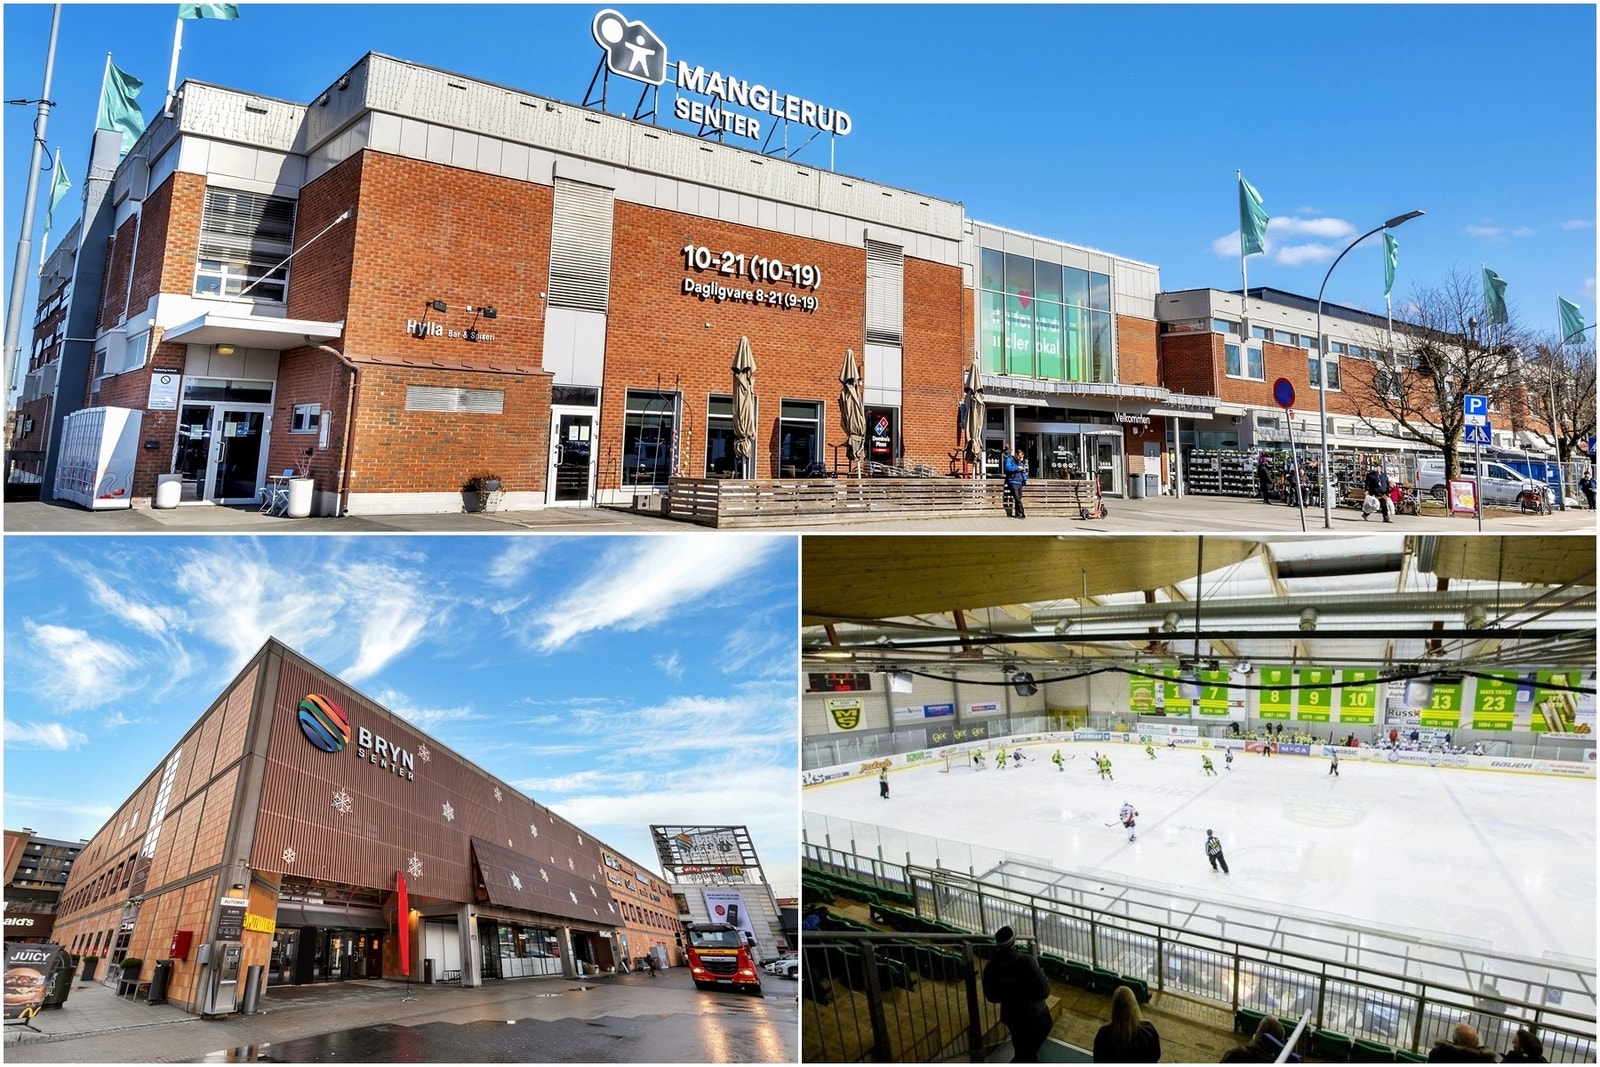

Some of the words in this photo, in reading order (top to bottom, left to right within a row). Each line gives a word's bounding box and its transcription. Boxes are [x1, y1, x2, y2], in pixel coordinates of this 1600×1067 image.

[677, 60, 852, 136] MANGLERUD
[675, 97, 760, 140] SENTER
[684, 244, 745, 276] 10-21
[751, 254, 821, 290] (10-19)
[684, 277, 754, 301] Dagligvare
[755, 288, 782, 305] 8-21
[784, 292, 819, 312] (9-19)
[406, 319, 443, 337] Hylla
[448, 329, 460, 338] Bar
[1470, 398, 1482, 413] P
[1114, 411, 1151, 425] Velkommen
[1209, 686, 1219, 700] 7
[1270, 690, 1280, 703] 8
[1309, 691, 1320, 705] 9
[1349, 692, 1368, 707] 10
[1431, 694, 1452, 710] 13
[1482, 695, 1506, 711] 23
[358, 726, 414, 771] BRYN
[358, 747, 414, 781] SENTER
[10, 951, 51, 962] JUICY
